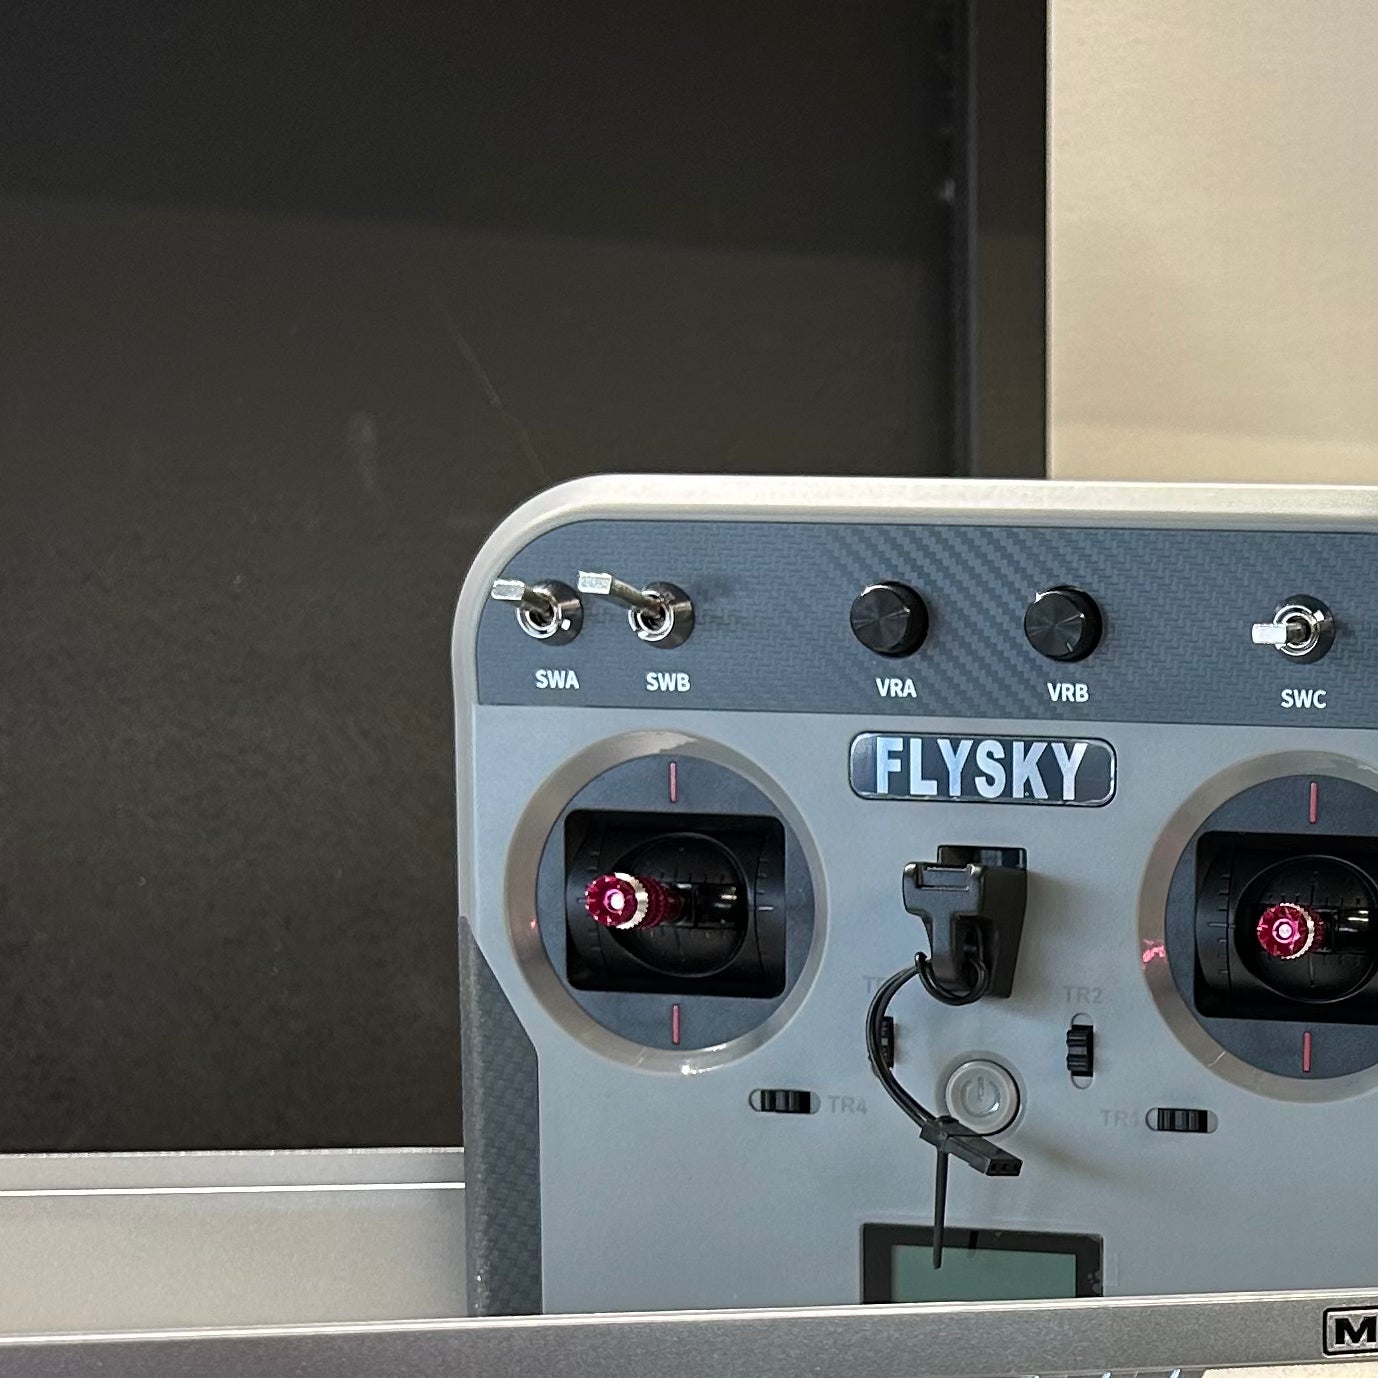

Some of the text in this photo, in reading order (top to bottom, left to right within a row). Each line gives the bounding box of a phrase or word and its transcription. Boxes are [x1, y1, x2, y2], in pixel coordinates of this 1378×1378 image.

[535, 669, 580, 690] SWA
[646, 671, 691, 692] SWB
[875, 677, 918, 698] VRA
[1046, 682, 1089, 703] VRB
[1280, 688, 1327, 709] SWC
[876, 736, 1089, 801] FLYSKY
[1063, 985, 1105, 1004] TR2
[828, 1096, 868, 1115] TR4
